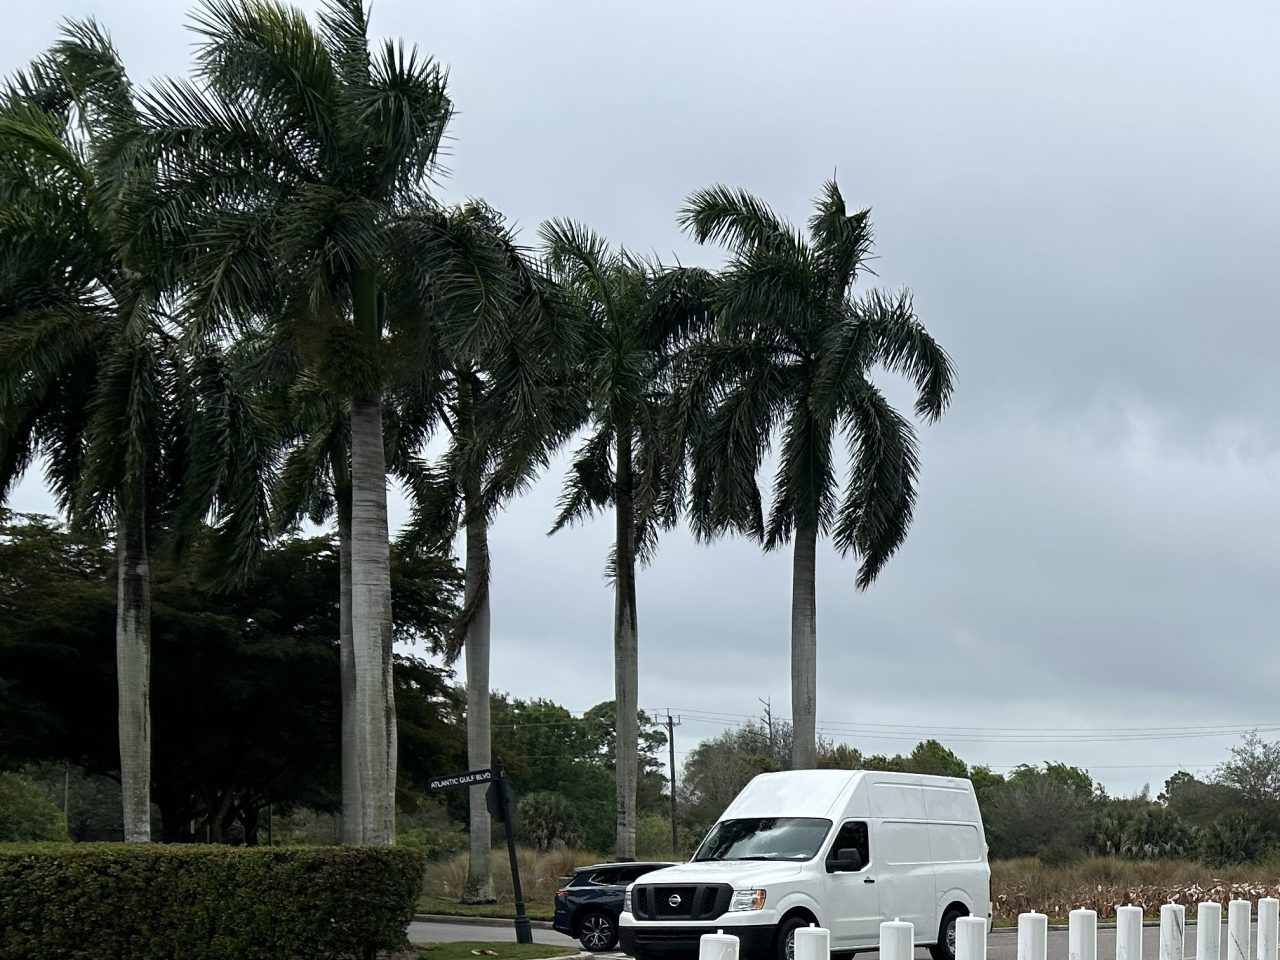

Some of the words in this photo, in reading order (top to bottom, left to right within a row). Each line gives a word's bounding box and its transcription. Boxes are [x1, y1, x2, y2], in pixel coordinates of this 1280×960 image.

[431, 778, 459, 788] ATLANTIC
[460, 775, 474, 783] GULF
[475, 772, 491, 781] BLVD
